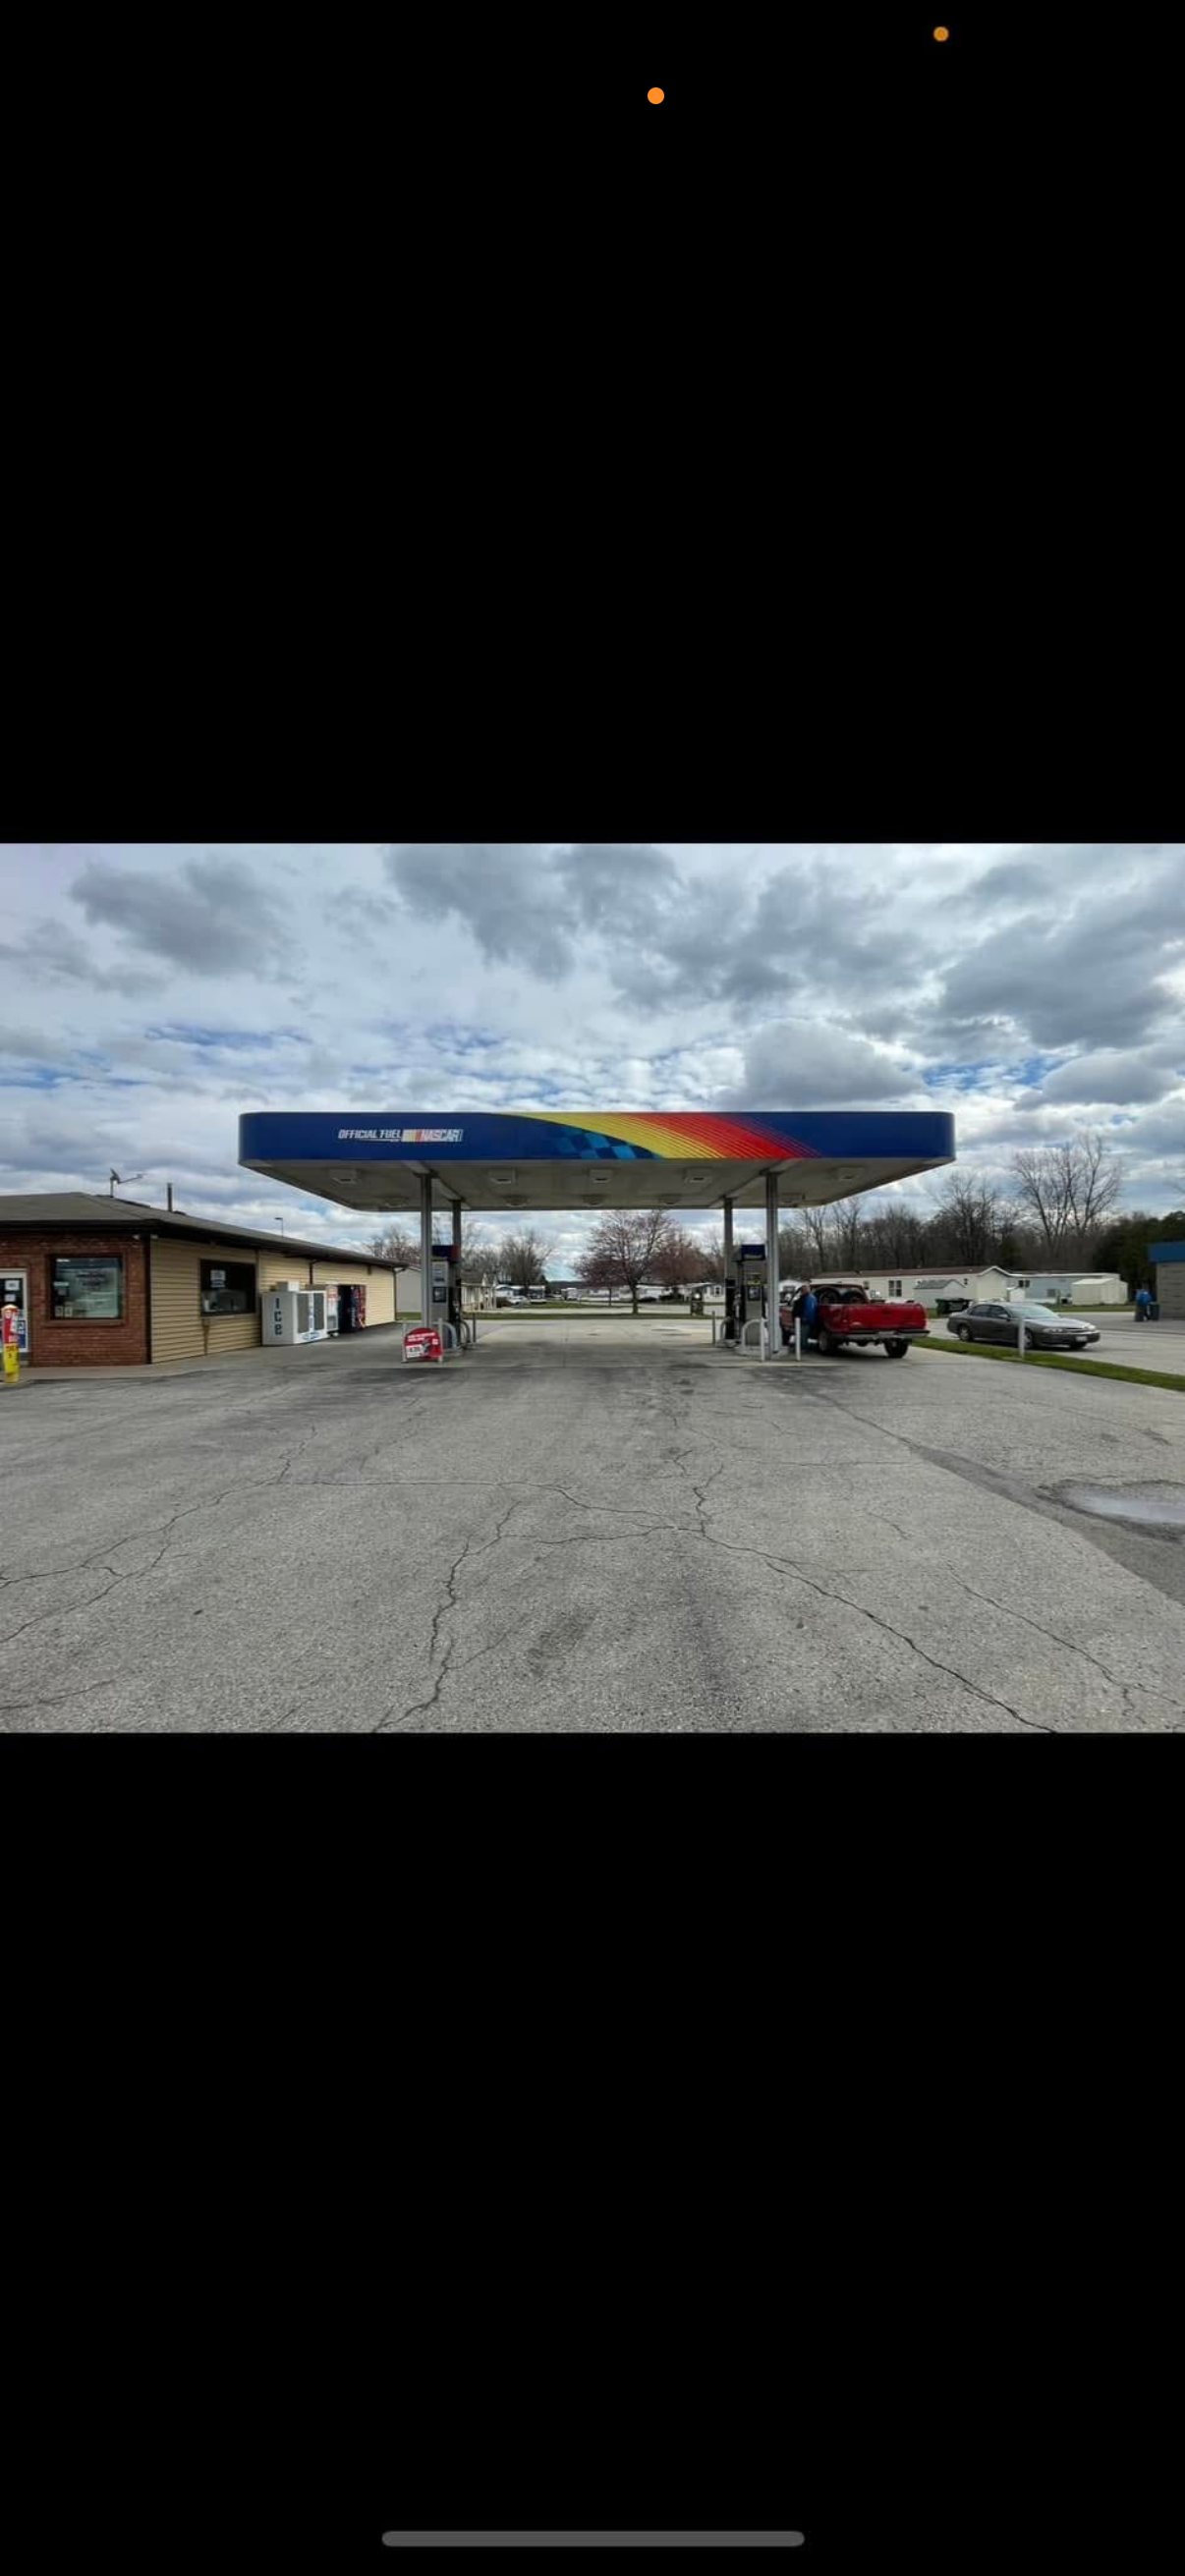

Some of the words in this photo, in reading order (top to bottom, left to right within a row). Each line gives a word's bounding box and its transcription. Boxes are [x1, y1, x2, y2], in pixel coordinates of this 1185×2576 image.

[338, 1129, 377, 1139] OFFICIAL
[379, 1129, 401, 1139] FUEL
[421, 1129, 462, 1142] NASCAR
